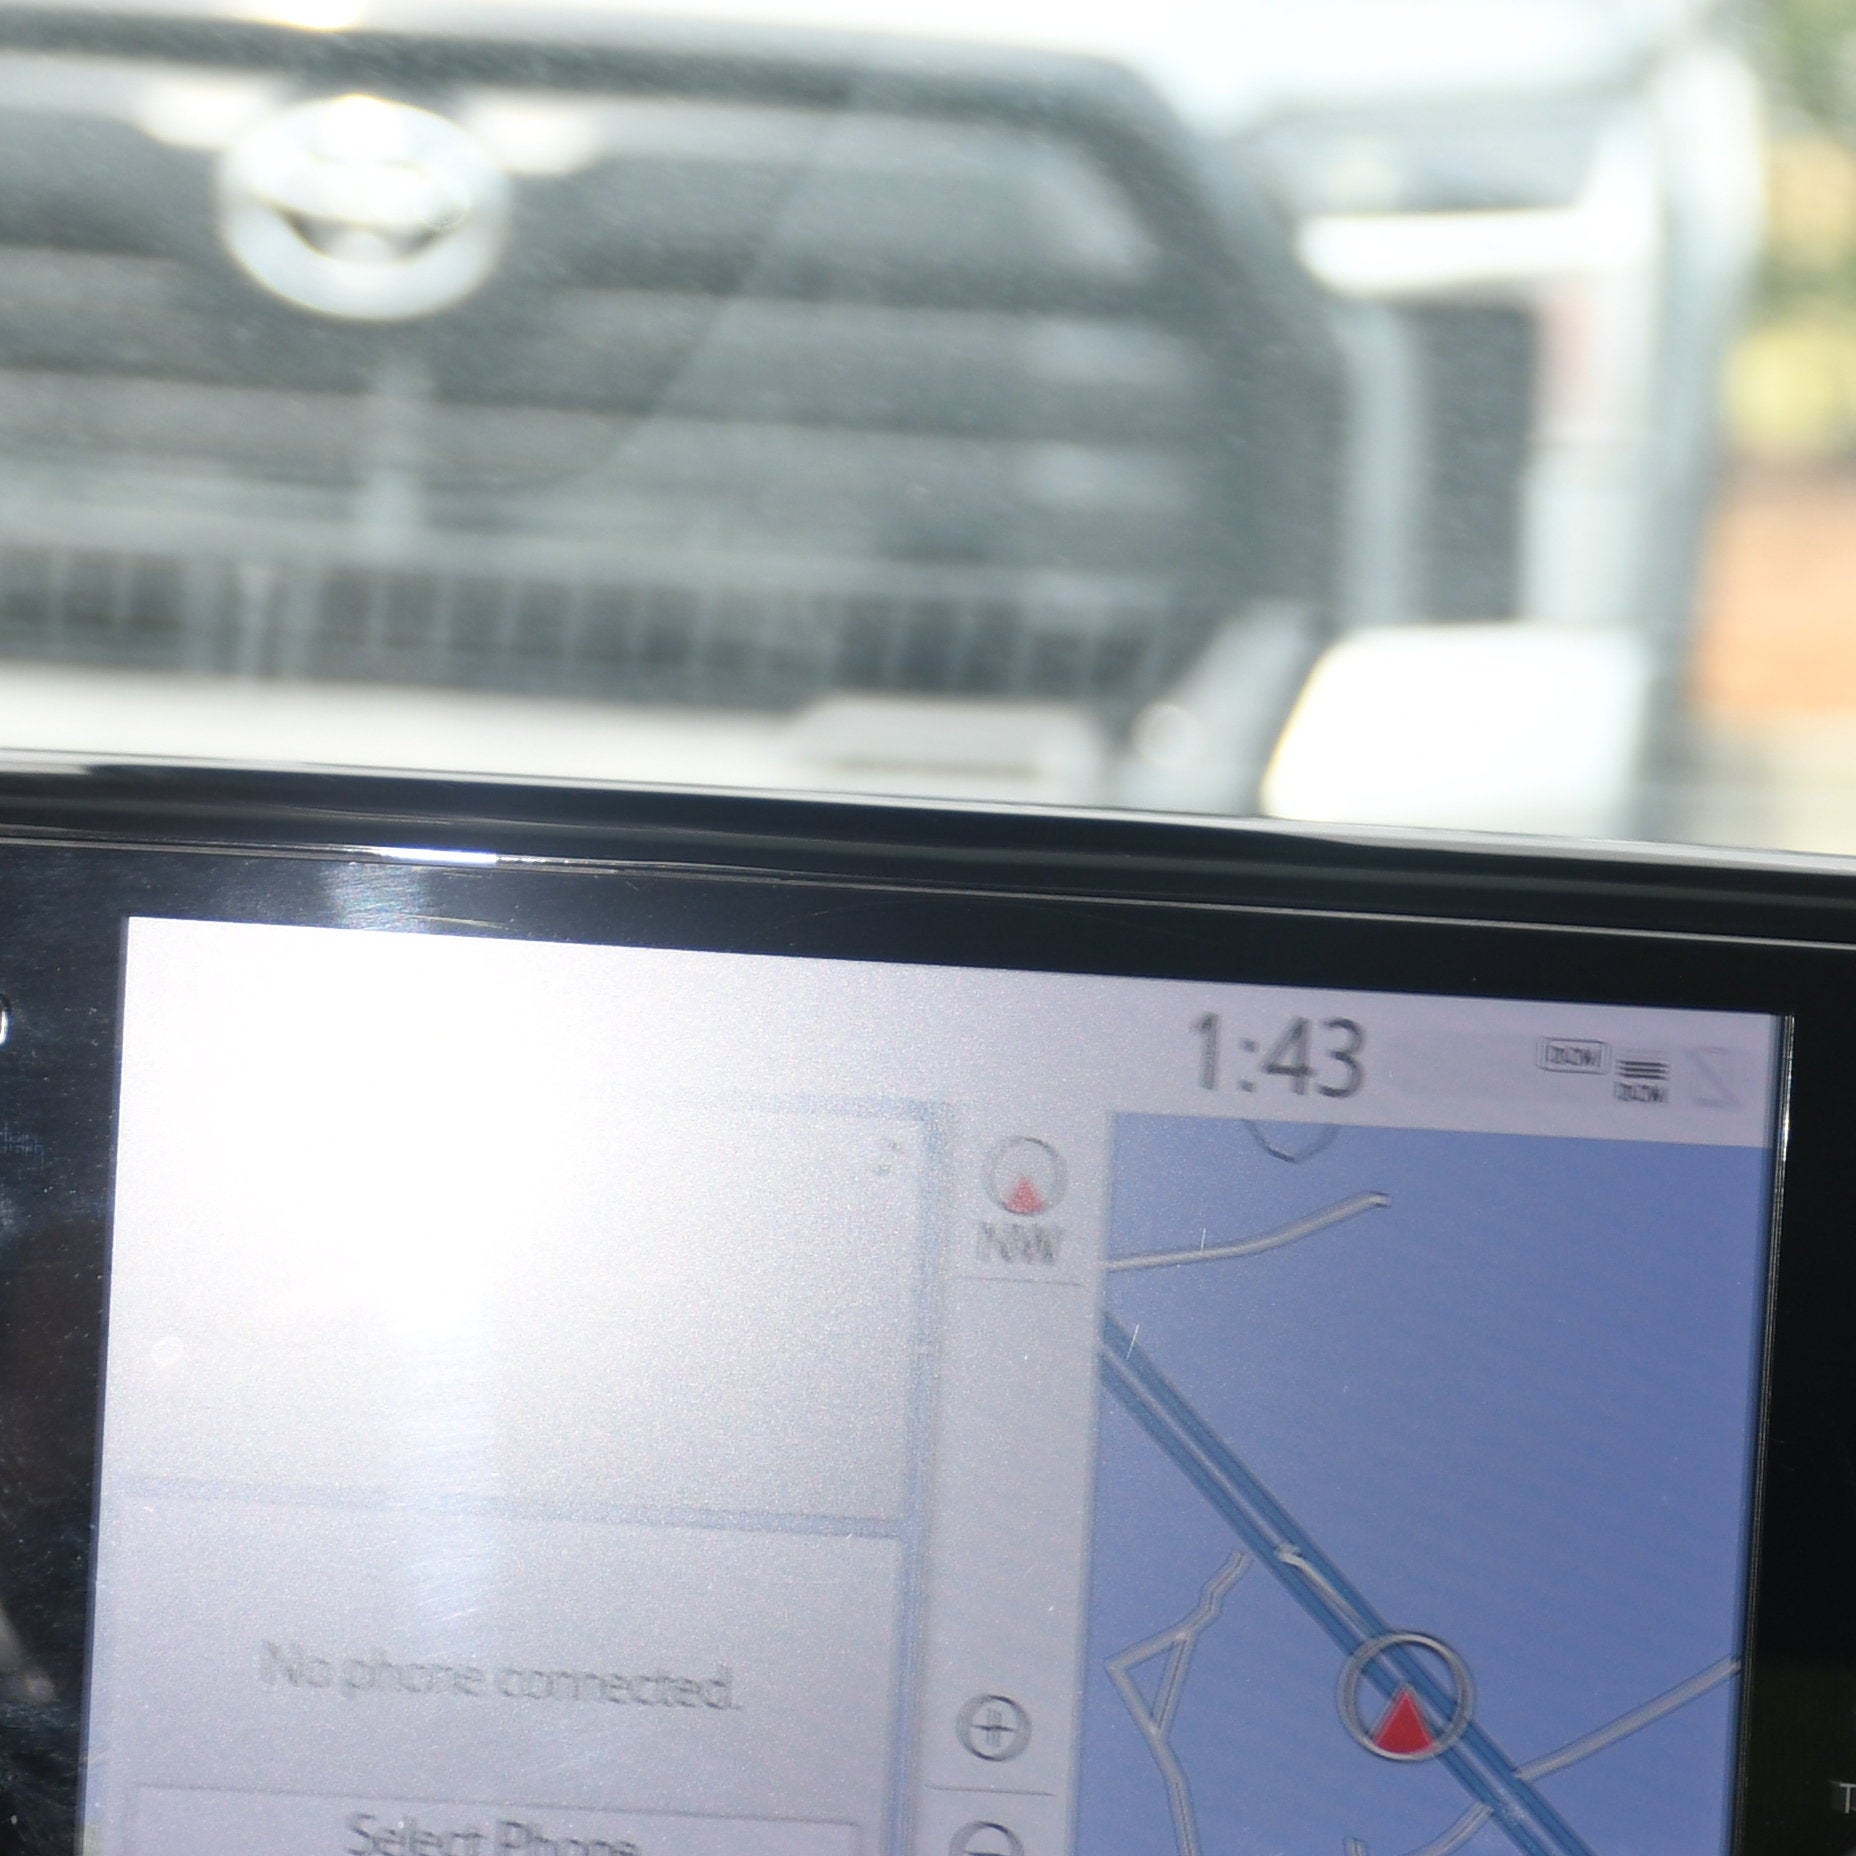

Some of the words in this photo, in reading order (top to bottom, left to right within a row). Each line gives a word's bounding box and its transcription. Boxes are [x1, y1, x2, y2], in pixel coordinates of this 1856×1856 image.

[1192, 1012, 1366, 1099] 1:43
[259, 1641, 331, 1688] No
[345, 1650, 485, 1699] phone
